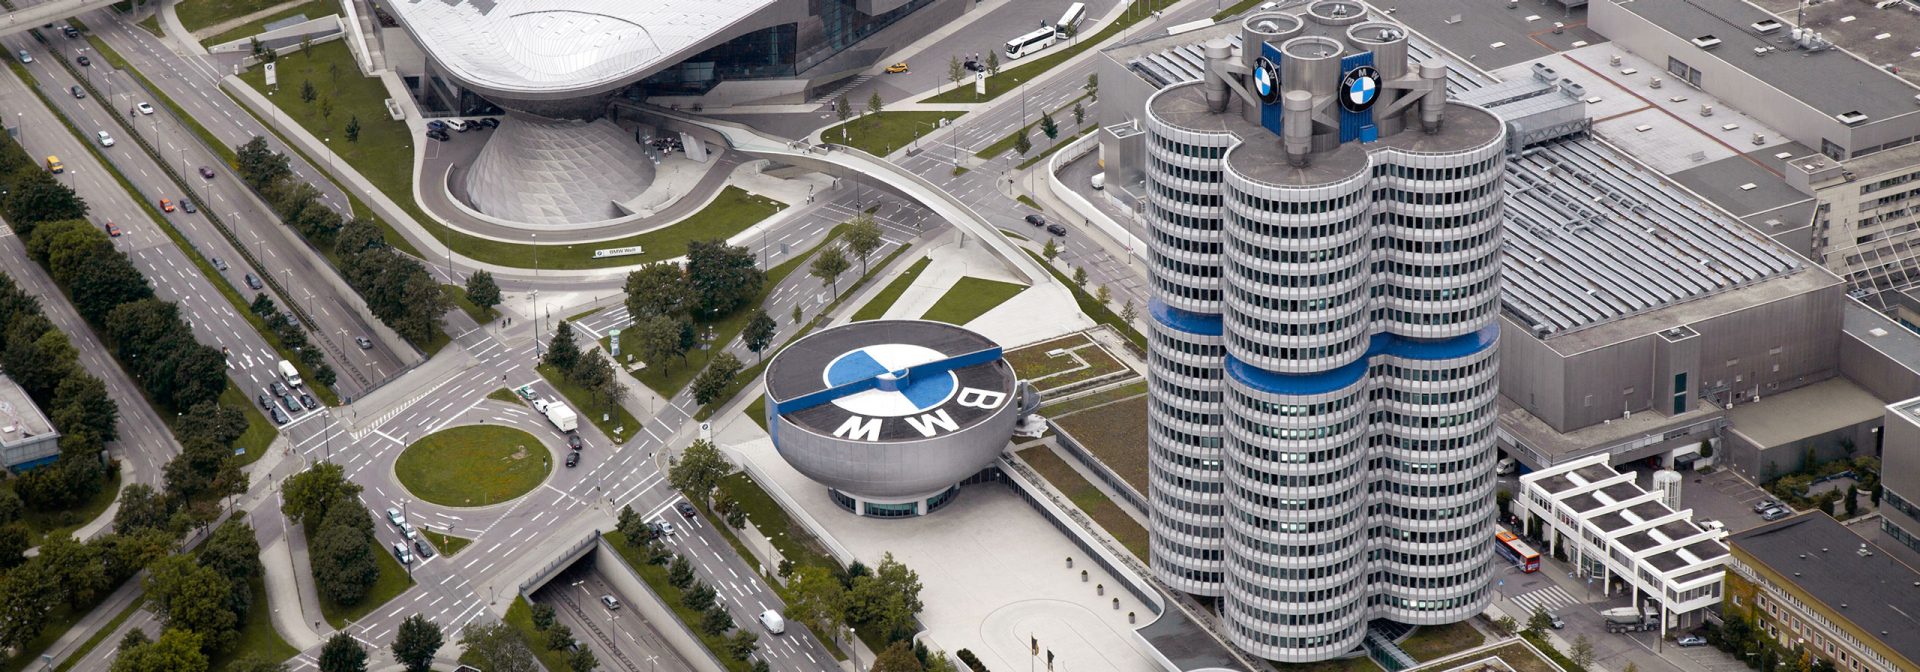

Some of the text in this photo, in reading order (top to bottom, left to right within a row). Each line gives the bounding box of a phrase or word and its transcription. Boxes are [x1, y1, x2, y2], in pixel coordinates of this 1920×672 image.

[1254, 60, 1275, 79] BMW
[1345, 68, 1380, 87] BMW
[832, 387, 1007, 441] BMW
